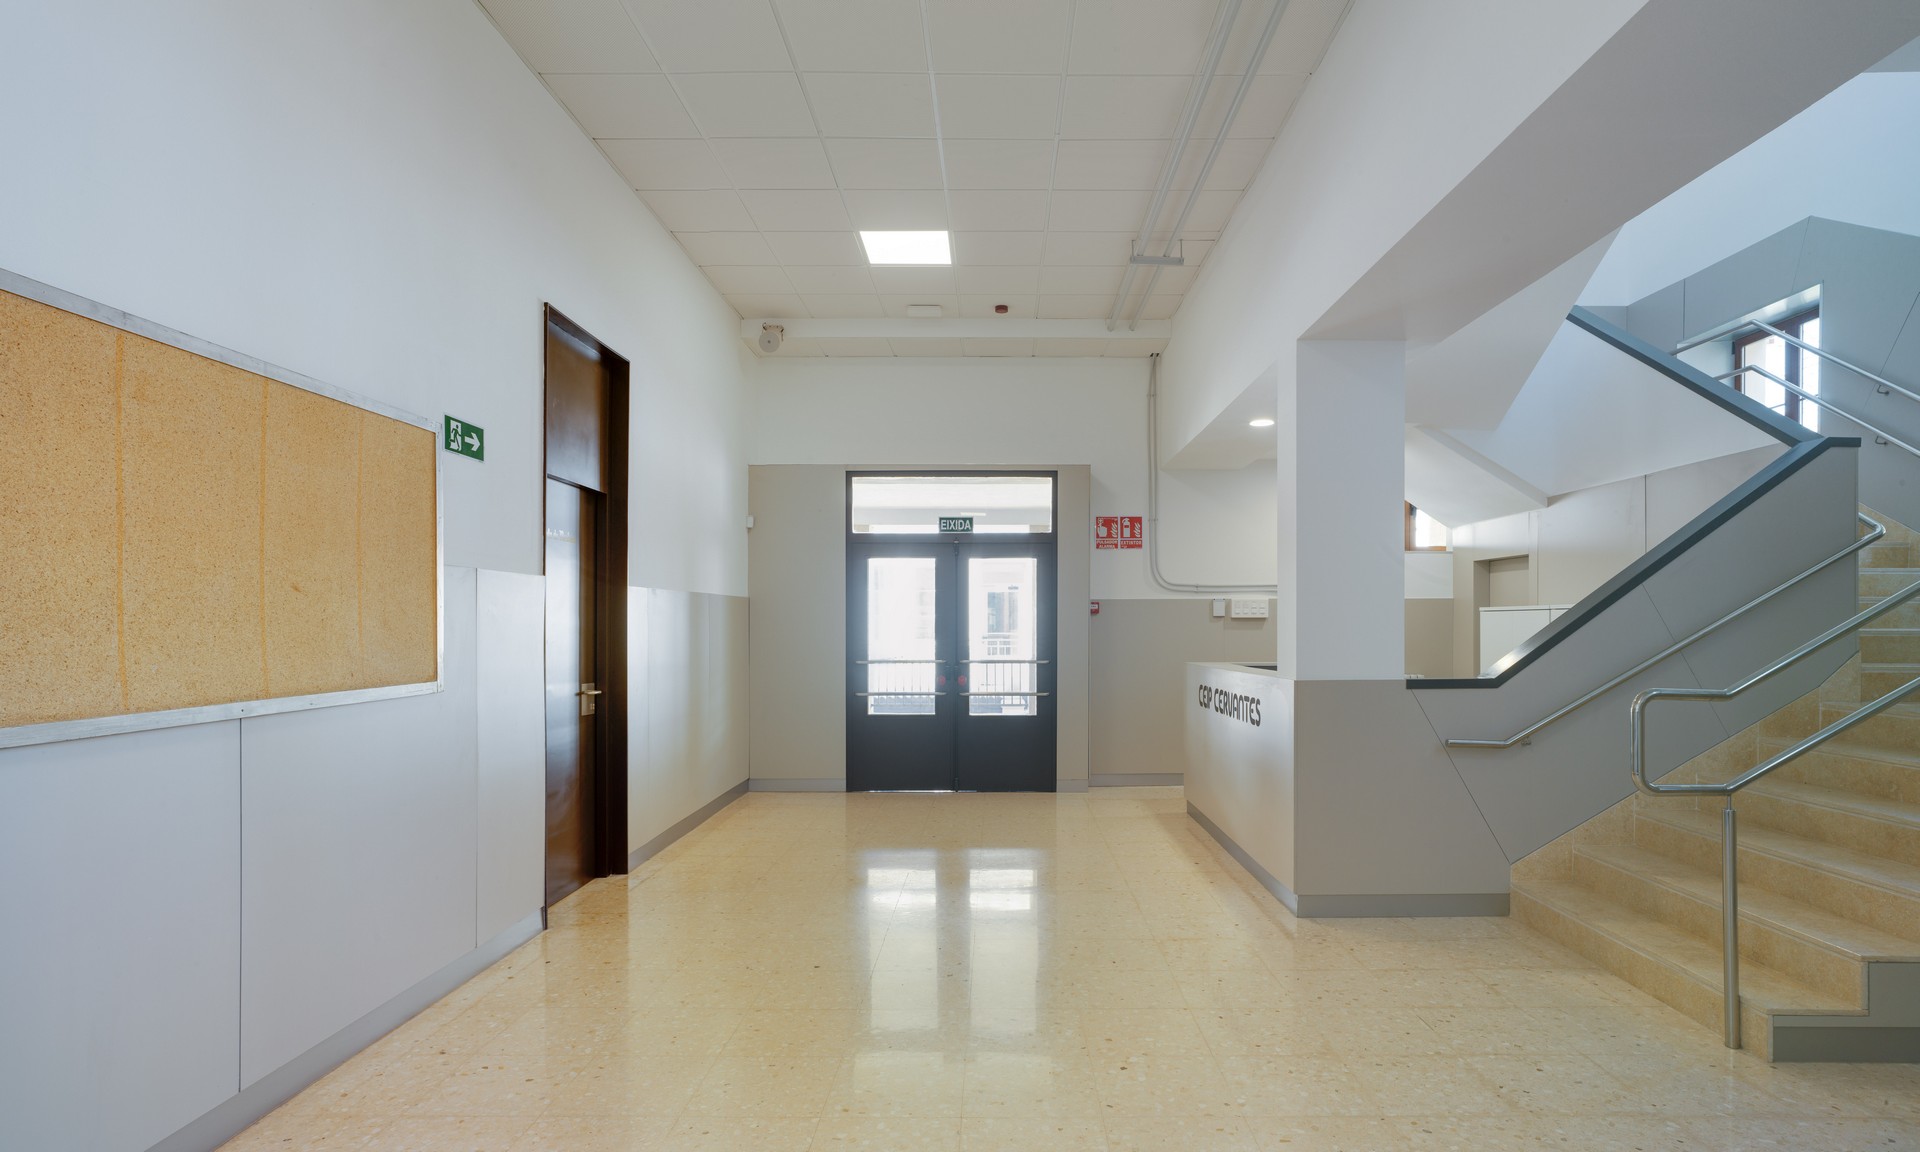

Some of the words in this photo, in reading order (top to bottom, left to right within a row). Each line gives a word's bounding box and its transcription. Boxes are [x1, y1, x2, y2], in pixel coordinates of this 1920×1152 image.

[940, 519, 971, 530] EIXIDA
[1198, 684, 1213, 709] CEIP
[1214, 688, 1261, 727] CERVANTES
